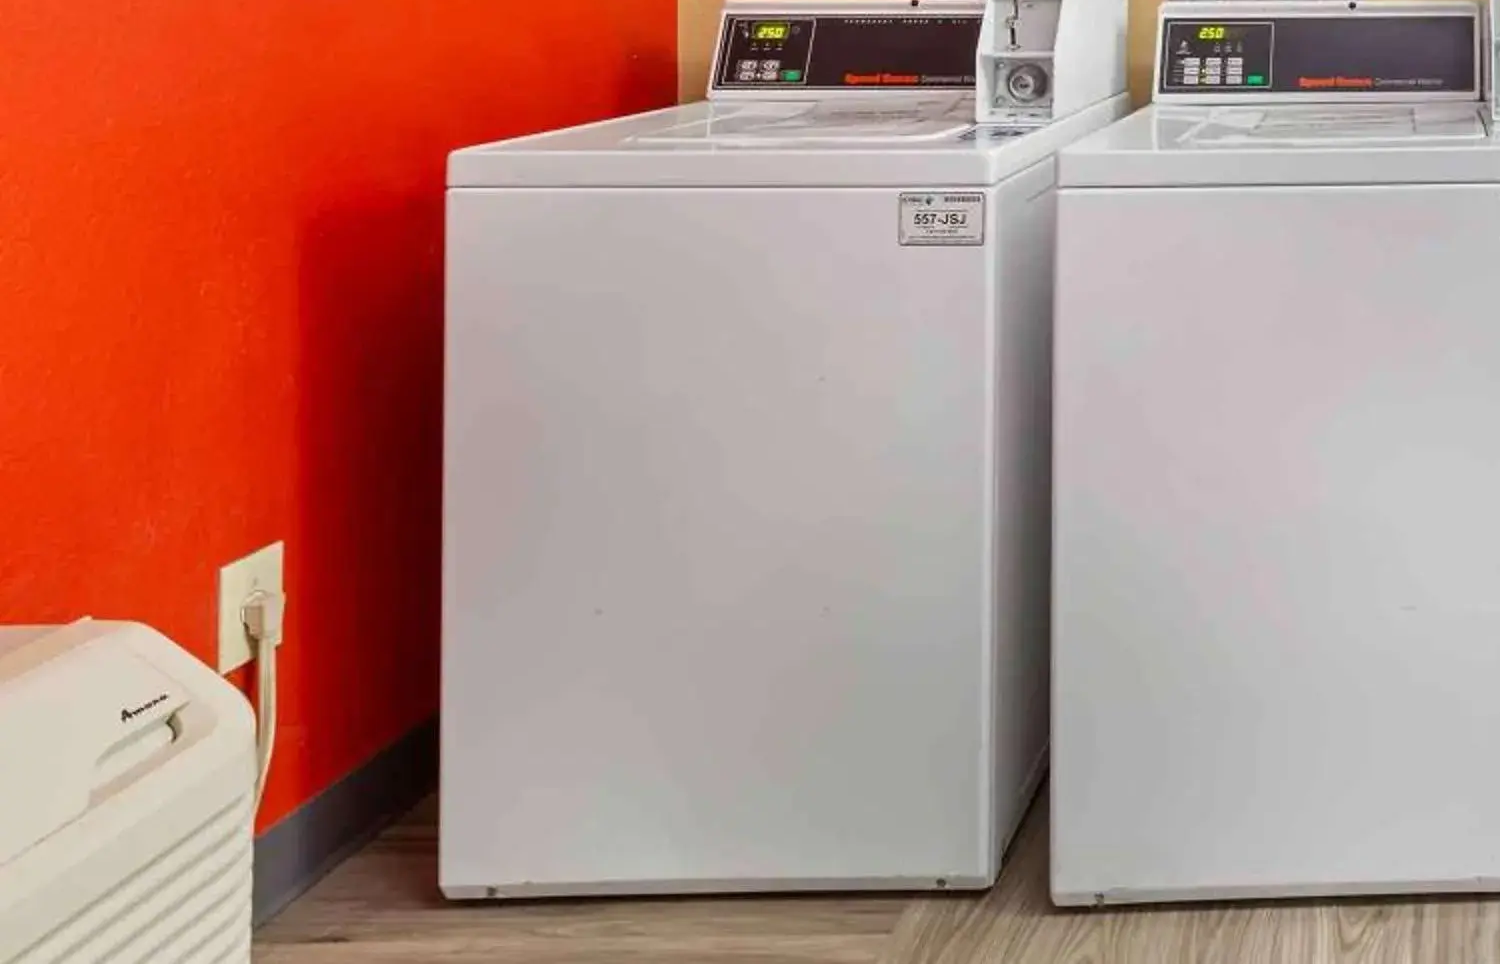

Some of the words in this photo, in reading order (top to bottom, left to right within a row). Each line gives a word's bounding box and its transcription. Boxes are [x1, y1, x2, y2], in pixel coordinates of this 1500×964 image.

[1199, 27, 1225, 39] 250
[914, 213, 967, 225] 557-JSJ
[121, 694, 169, 723] Amana
